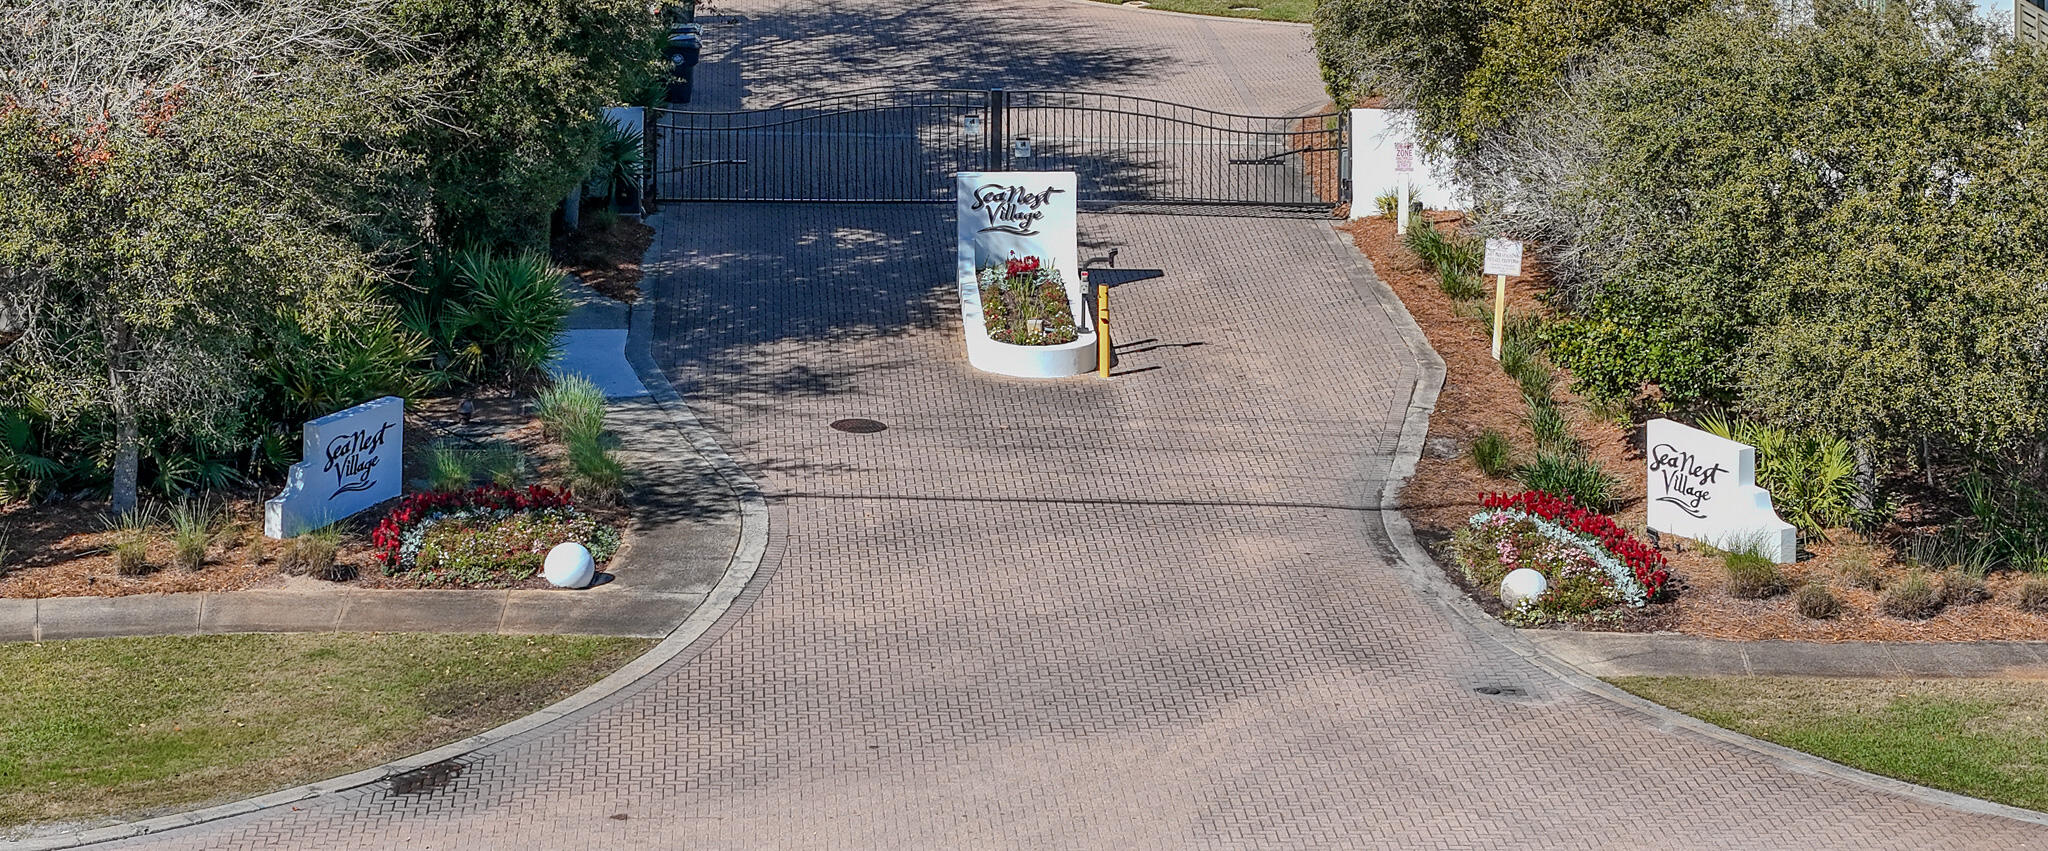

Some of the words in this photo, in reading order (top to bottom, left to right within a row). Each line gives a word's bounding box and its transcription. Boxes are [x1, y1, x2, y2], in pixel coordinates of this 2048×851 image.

[971, 184, 1006, 210] Sea
[1004, 186, 1066, 210] Nest
[985, 201, 1044, 229] Village
[323, 435, 351, 472] Sea
[351, 422, 396, 455] Nest
[1650, 444, 1679, 471] Sea
[1680, 452, 1729, 485] Nest
[335, 454, 380, 487] Village
[1661, 469, 1712, 508] Village
